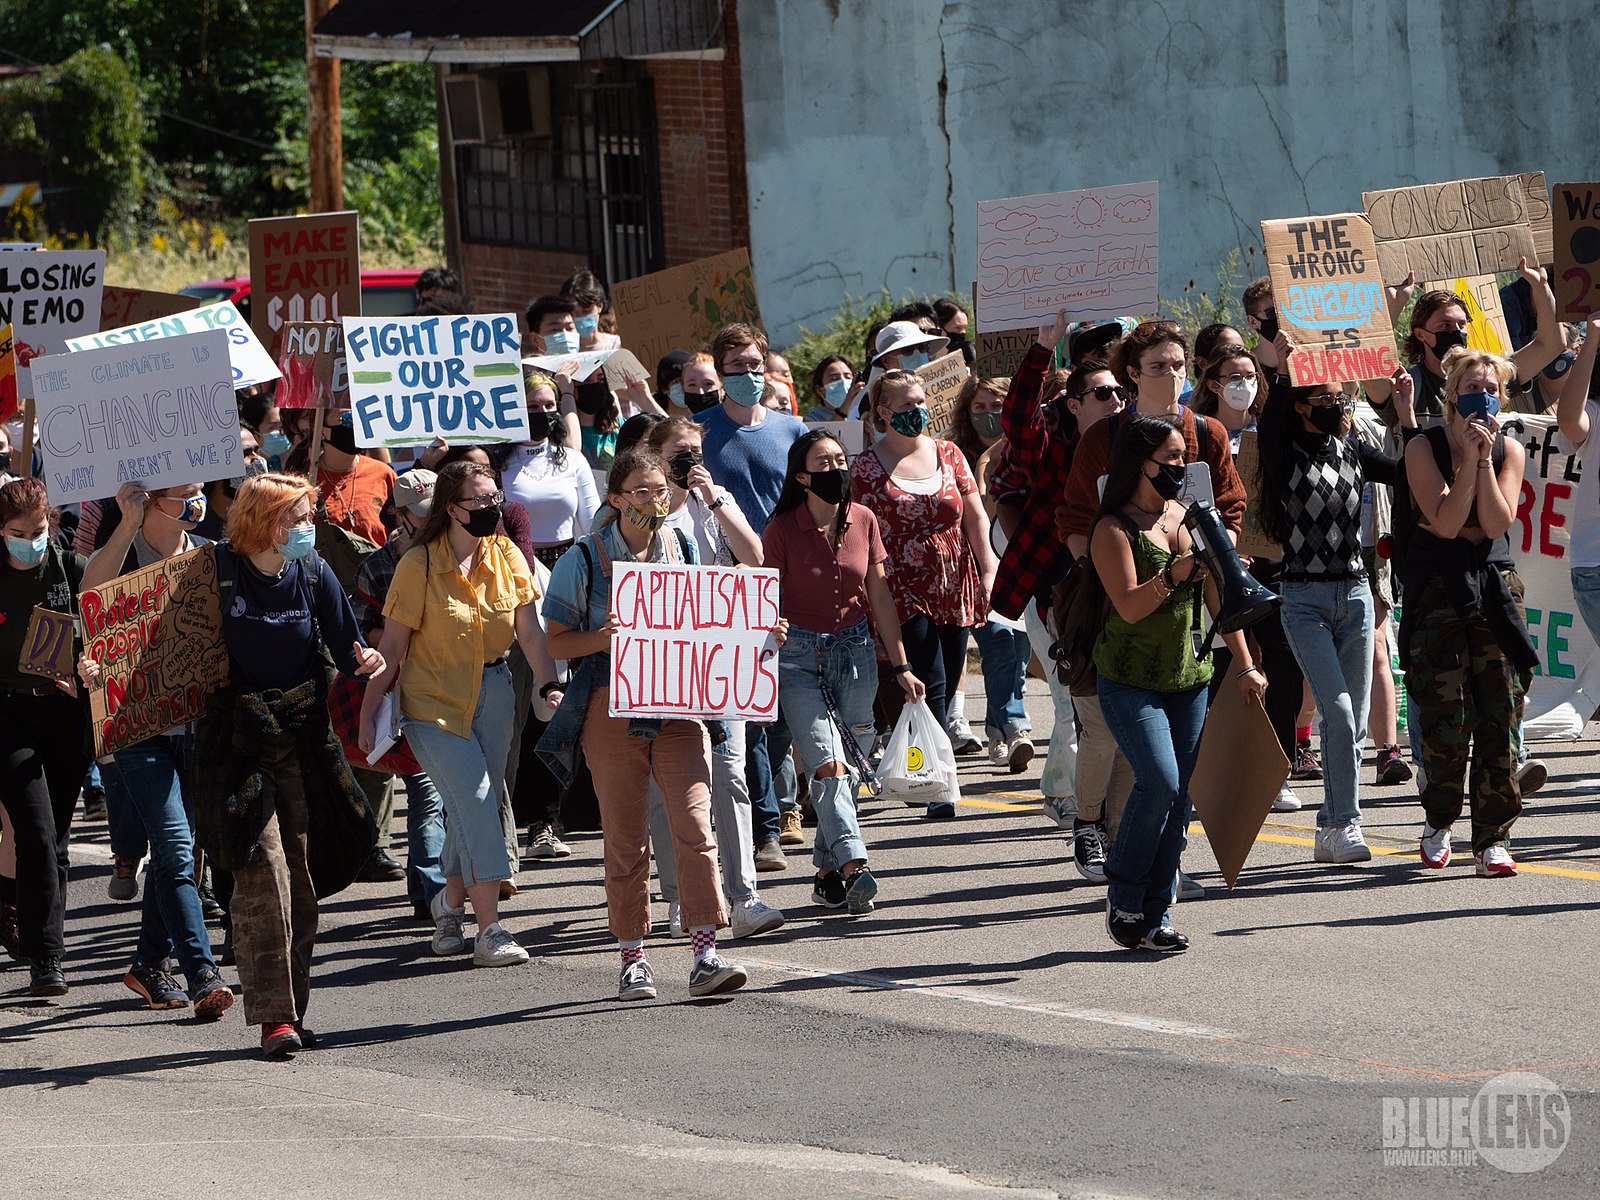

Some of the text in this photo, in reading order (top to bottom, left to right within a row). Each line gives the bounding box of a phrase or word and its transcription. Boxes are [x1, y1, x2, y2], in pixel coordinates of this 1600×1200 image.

[1367, 174, 1549, 239] CONGRESS
[263, 226, 348, 258] MAKE
[1287, 218, 1352, 252] THE
[1421, 231, 1511, 275] WTF?
[0, 262, 96, 294] LOSING
[264, 258, 349, 293] EARTH
[979, 241, 1150, 292] Save our Earth
[1287, 249, 1366, 279] WRONG
[615, 276, 672, 316] HEAL
[1287, 280, 1384, 317] amazon
[194, 305, 238, 329] TO
[286, 326, 321, 355] NO
[347, 316, 521, 363] FIGHT FOR
[1321, 327, 1360, 350] IS
[35, 345, 210, 393] THE CLIMATE IS
[398, 358, 470, 389] OUR
[1291, 346, 1396, 386] BURNING
[931, 374, 961, 396] CARBON
[934, 394, 944, 403] TO
[41, 381, 237, 457] CHANGING
[355, 384, 525, 439] FUTURE
[54, 465, 95, 492] WHY
[116, 450, 172, 482] AREN'T
[168, 554, 198, 575] INCREASE
[173, 569, 187, 583] THE
[178, 574, 202, 592] PEACE
[80, 574, 169, 637] Protect
[615, 569, 779, 631] CAPITALISM IS
[105, 656, 163, 714] NOT
[614, 635, 778, 713] KILLING US
